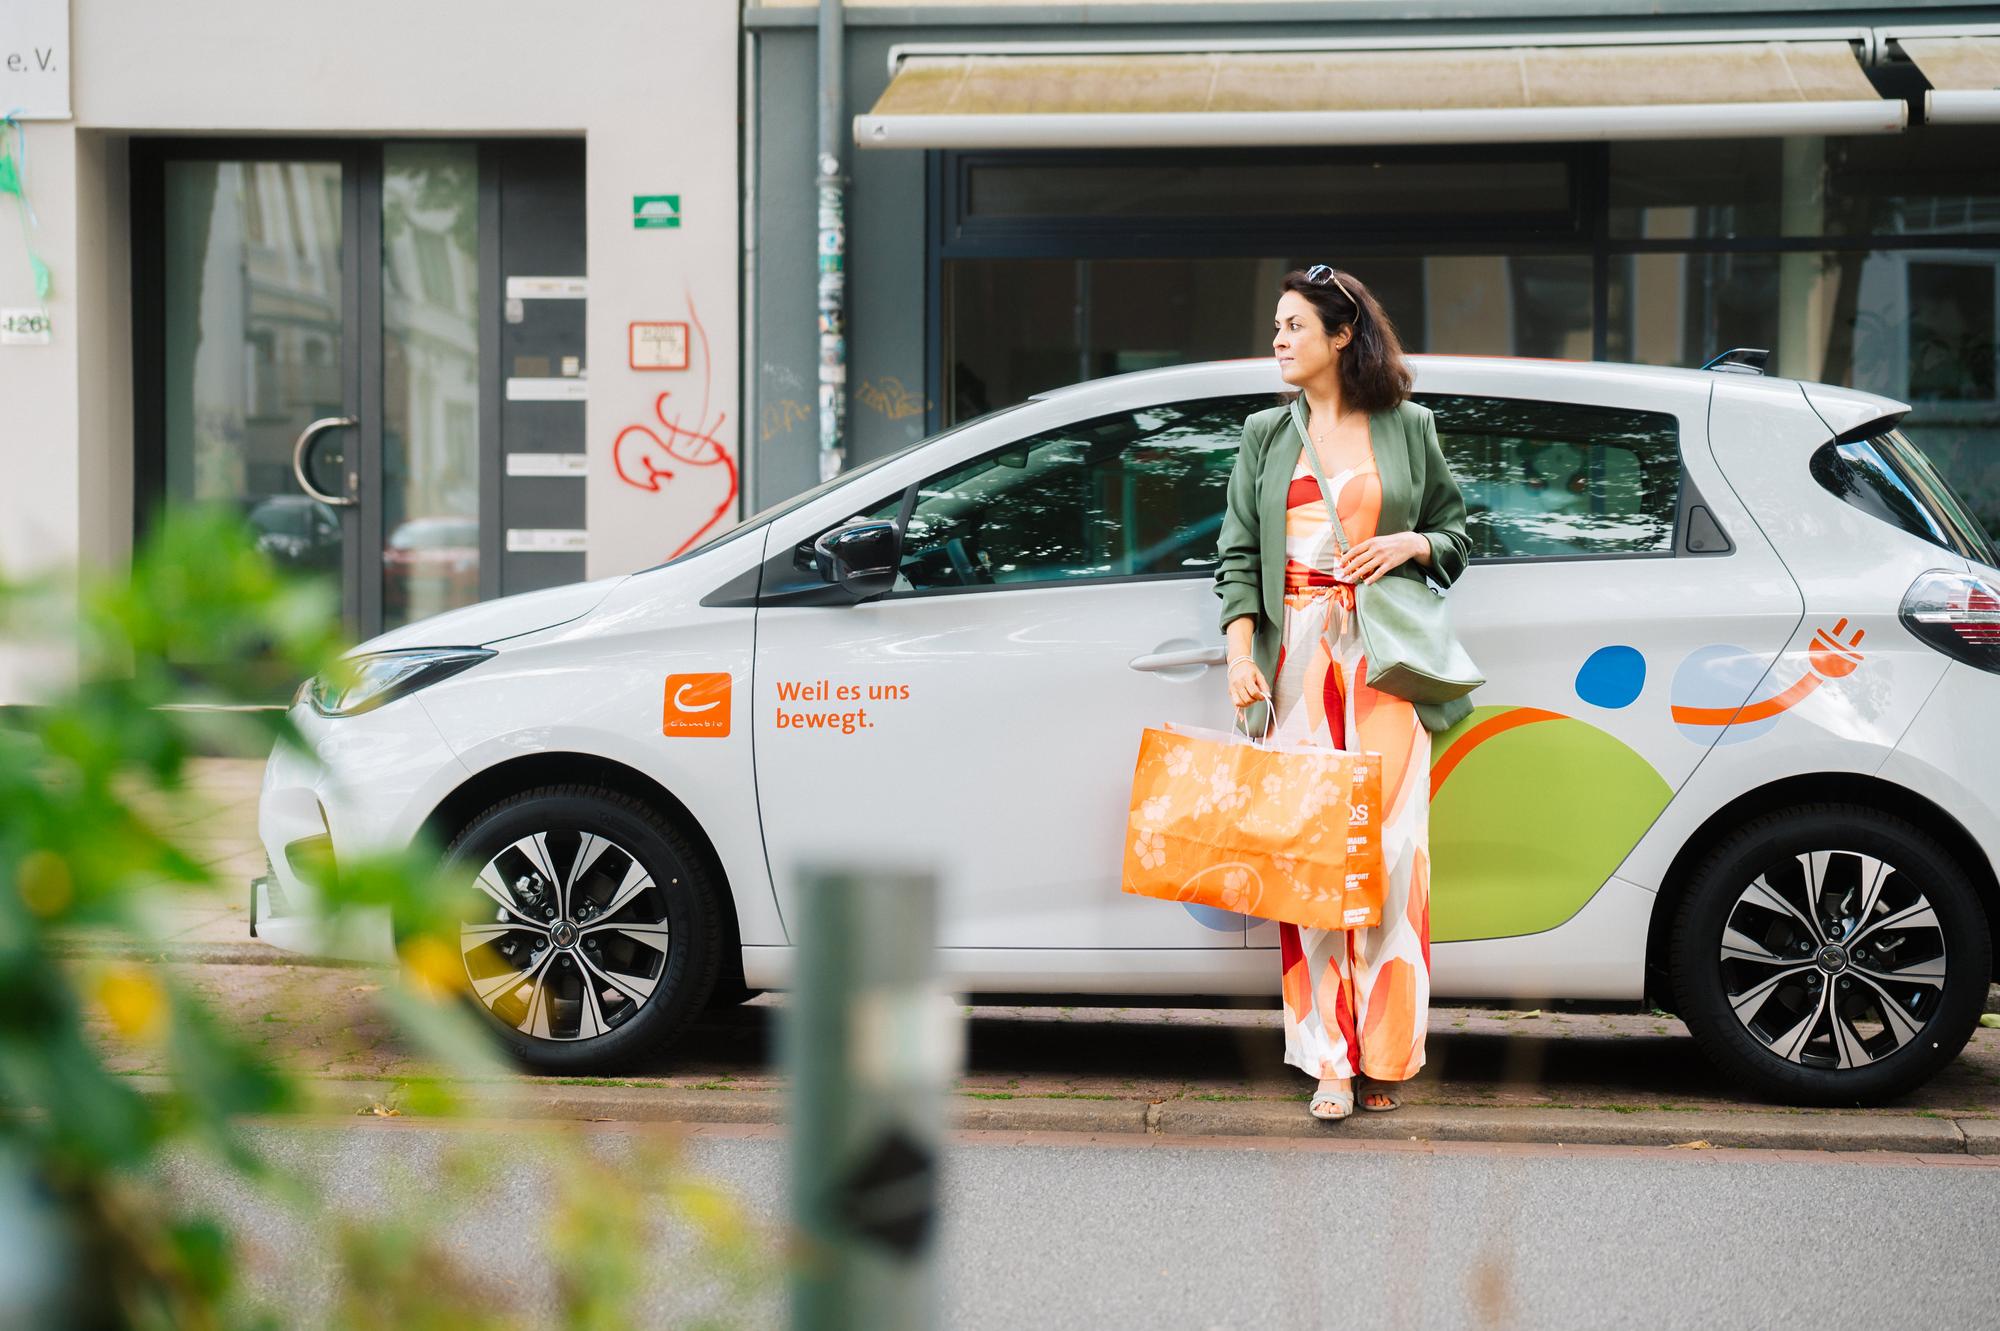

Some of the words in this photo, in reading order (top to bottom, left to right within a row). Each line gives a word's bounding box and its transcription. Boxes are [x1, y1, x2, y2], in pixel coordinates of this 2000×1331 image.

[7, 53, 28, 72] e.
[35, 47, 56, 72] V.
[776, 680, 829, 701] Weil
[836, 684, 861, 701] es
[868, 684, 910, 700] uns
[776, 708, 874, 734] bewegt.
